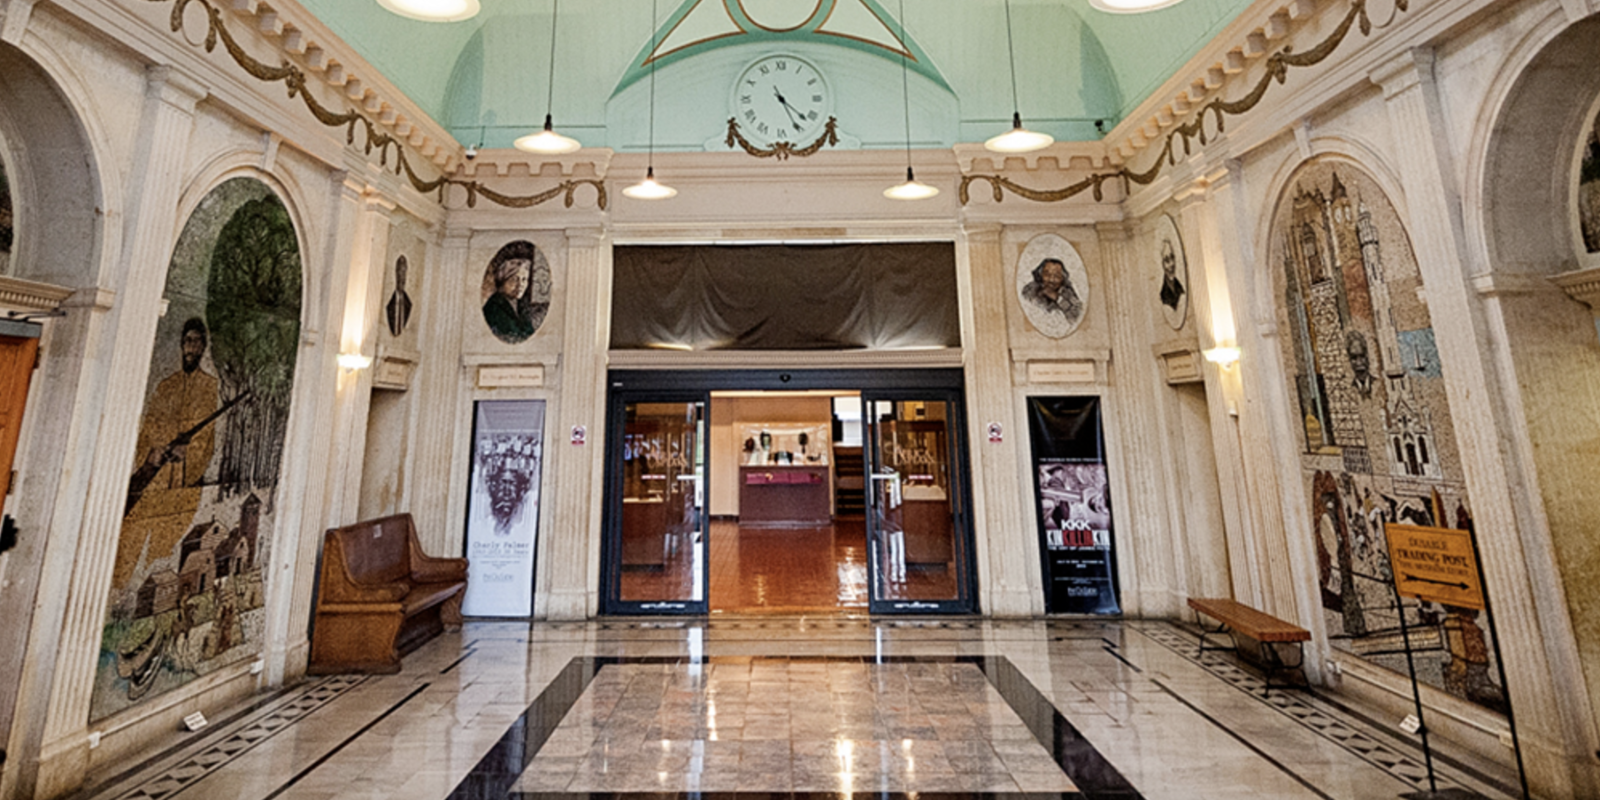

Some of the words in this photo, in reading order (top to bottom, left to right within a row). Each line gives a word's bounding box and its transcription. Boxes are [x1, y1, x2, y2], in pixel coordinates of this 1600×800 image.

[776, 60, 786, 71] XII
[795, 65, 803, 74] I
[746, 79, 756, 87] X
[741, 95, 751, 104] IX
[1061, 519, 1091, 530] KKK
[503, 541, 529, 549] Palmer
[1397, 548, 1440, 563] TRADING
